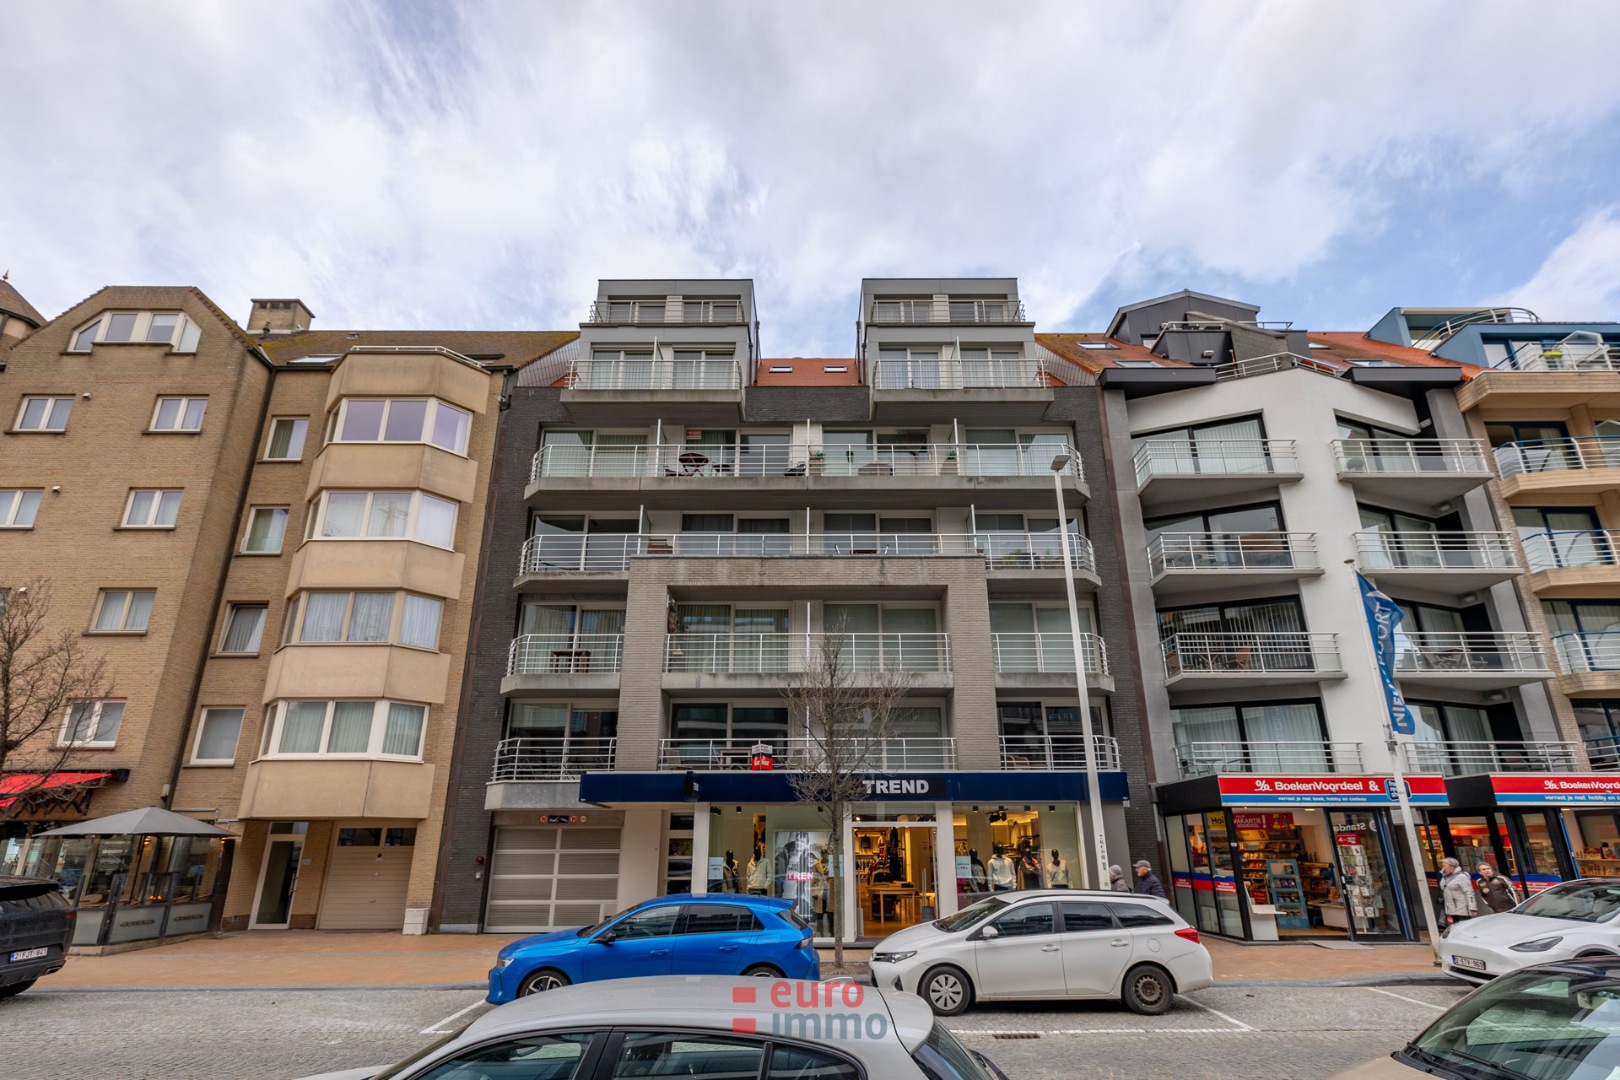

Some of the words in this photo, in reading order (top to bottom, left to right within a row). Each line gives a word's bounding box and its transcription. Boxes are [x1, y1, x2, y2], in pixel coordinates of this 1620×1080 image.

[862, 779, 930, 794] TREND
[1274, 781, 1364, 791] BoekenVoordeel
[1368, 780, 1380, 792] &
